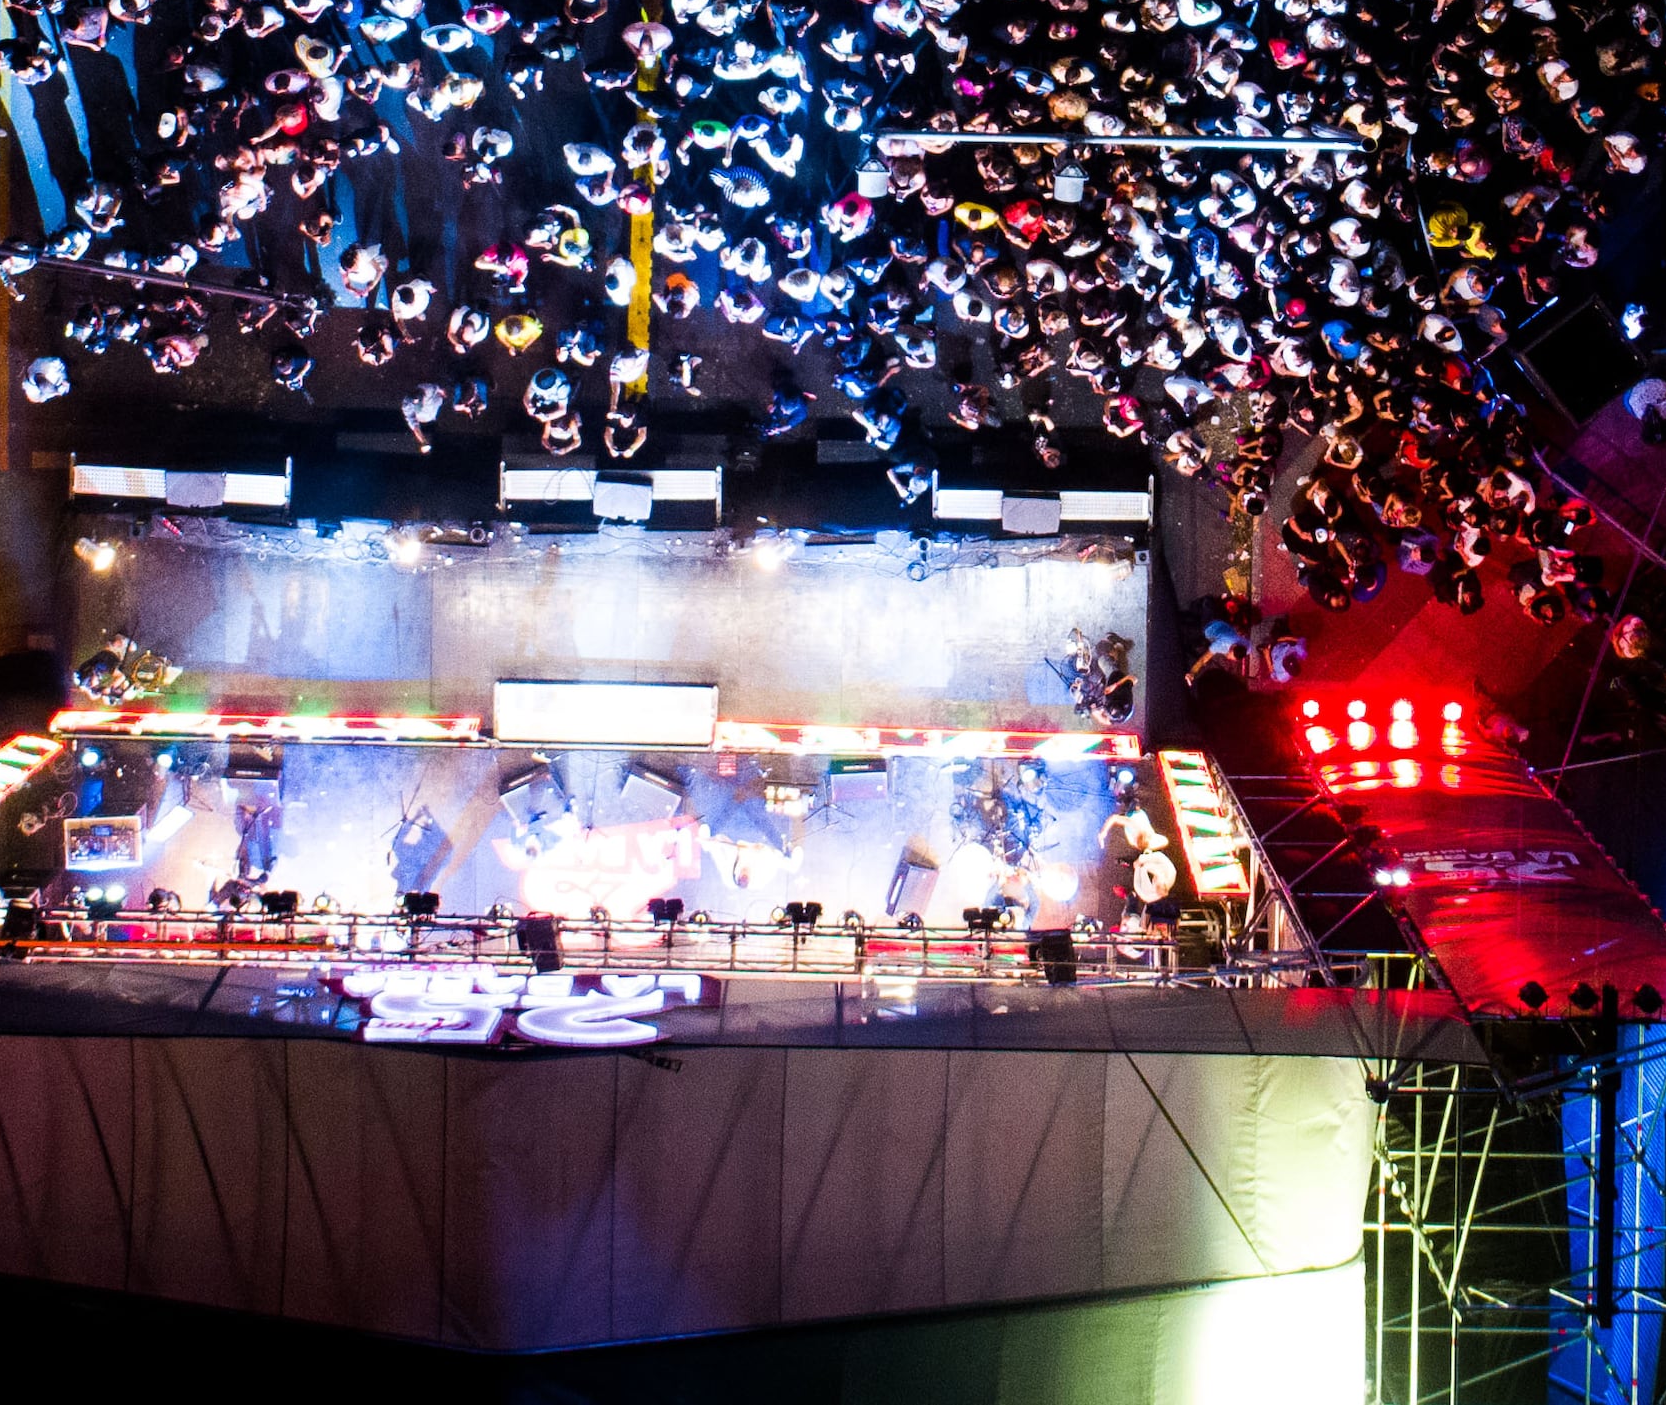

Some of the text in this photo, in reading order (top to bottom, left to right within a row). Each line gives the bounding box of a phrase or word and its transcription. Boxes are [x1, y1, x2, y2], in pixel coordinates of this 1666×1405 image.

[1526, 850, 1580, 865] LA
[600, 974, 702, 1003] LA
[364, 989, 665, 1045] 25
